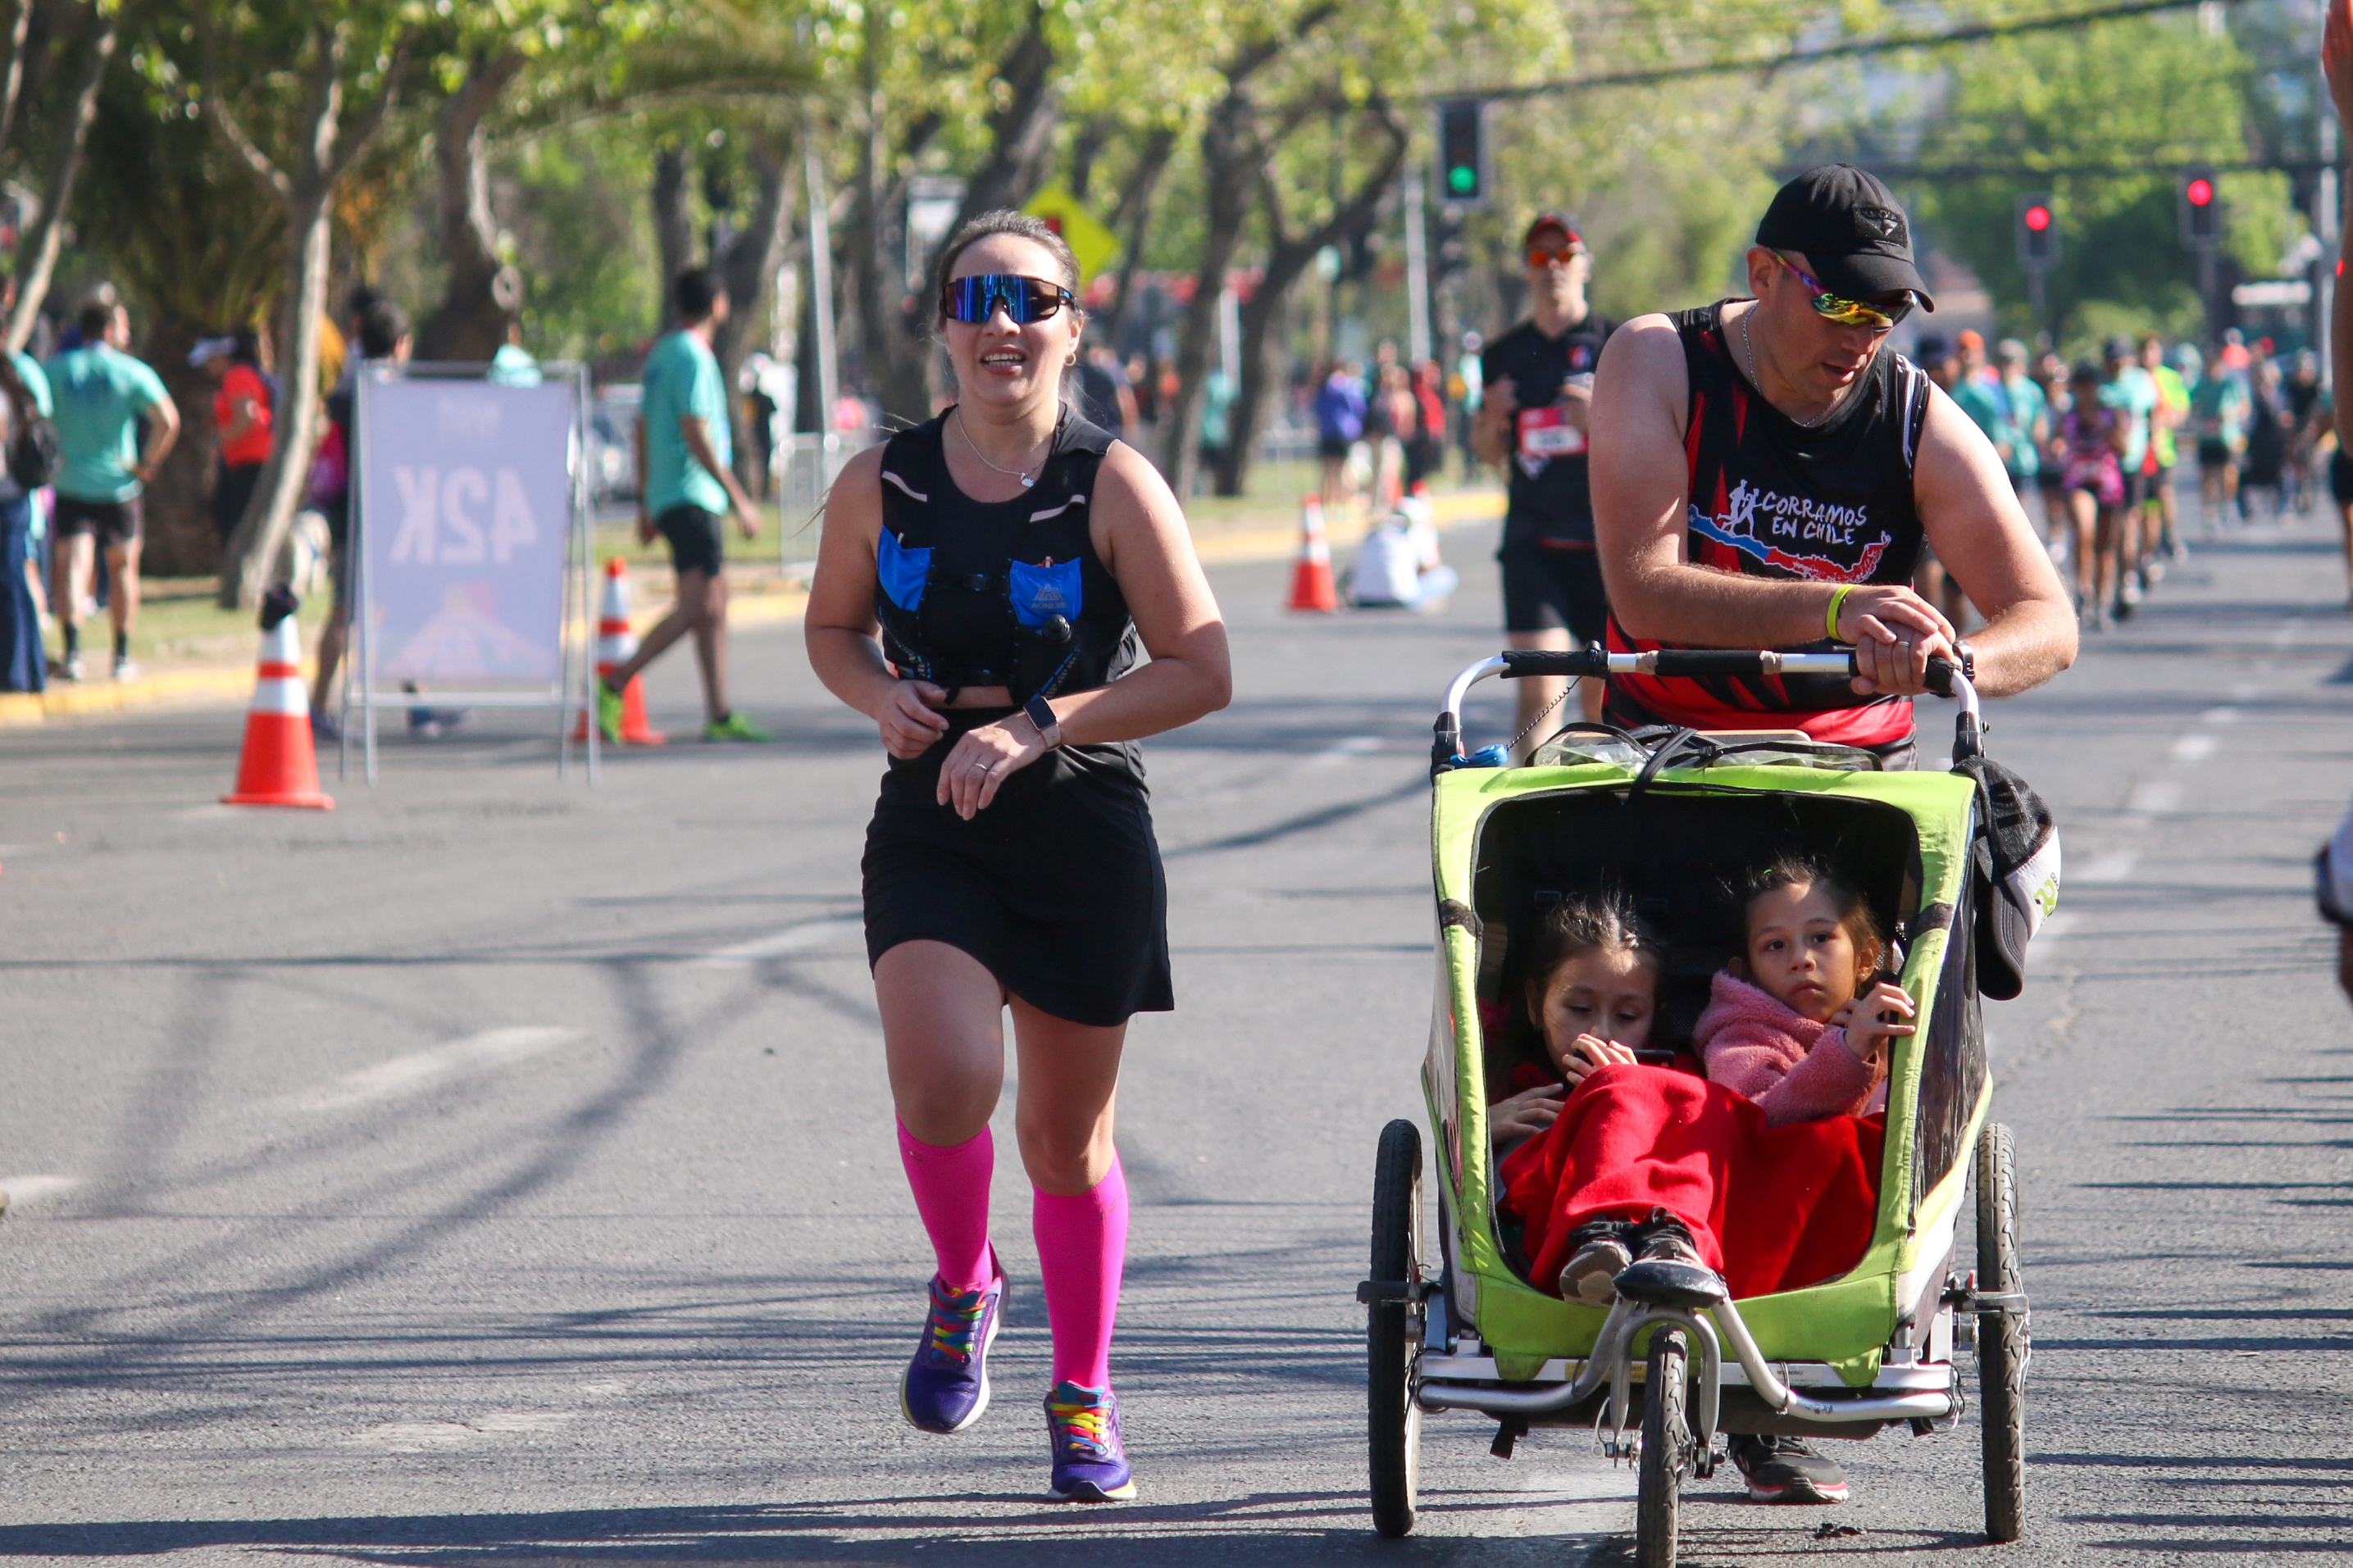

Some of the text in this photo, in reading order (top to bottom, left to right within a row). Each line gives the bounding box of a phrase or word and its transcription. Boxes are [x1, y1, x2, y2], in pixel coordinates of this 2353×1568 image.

[1762, 492, 1867, 526] CORRAMOS
[1773, 516, 1855, 544] EN CHILE
